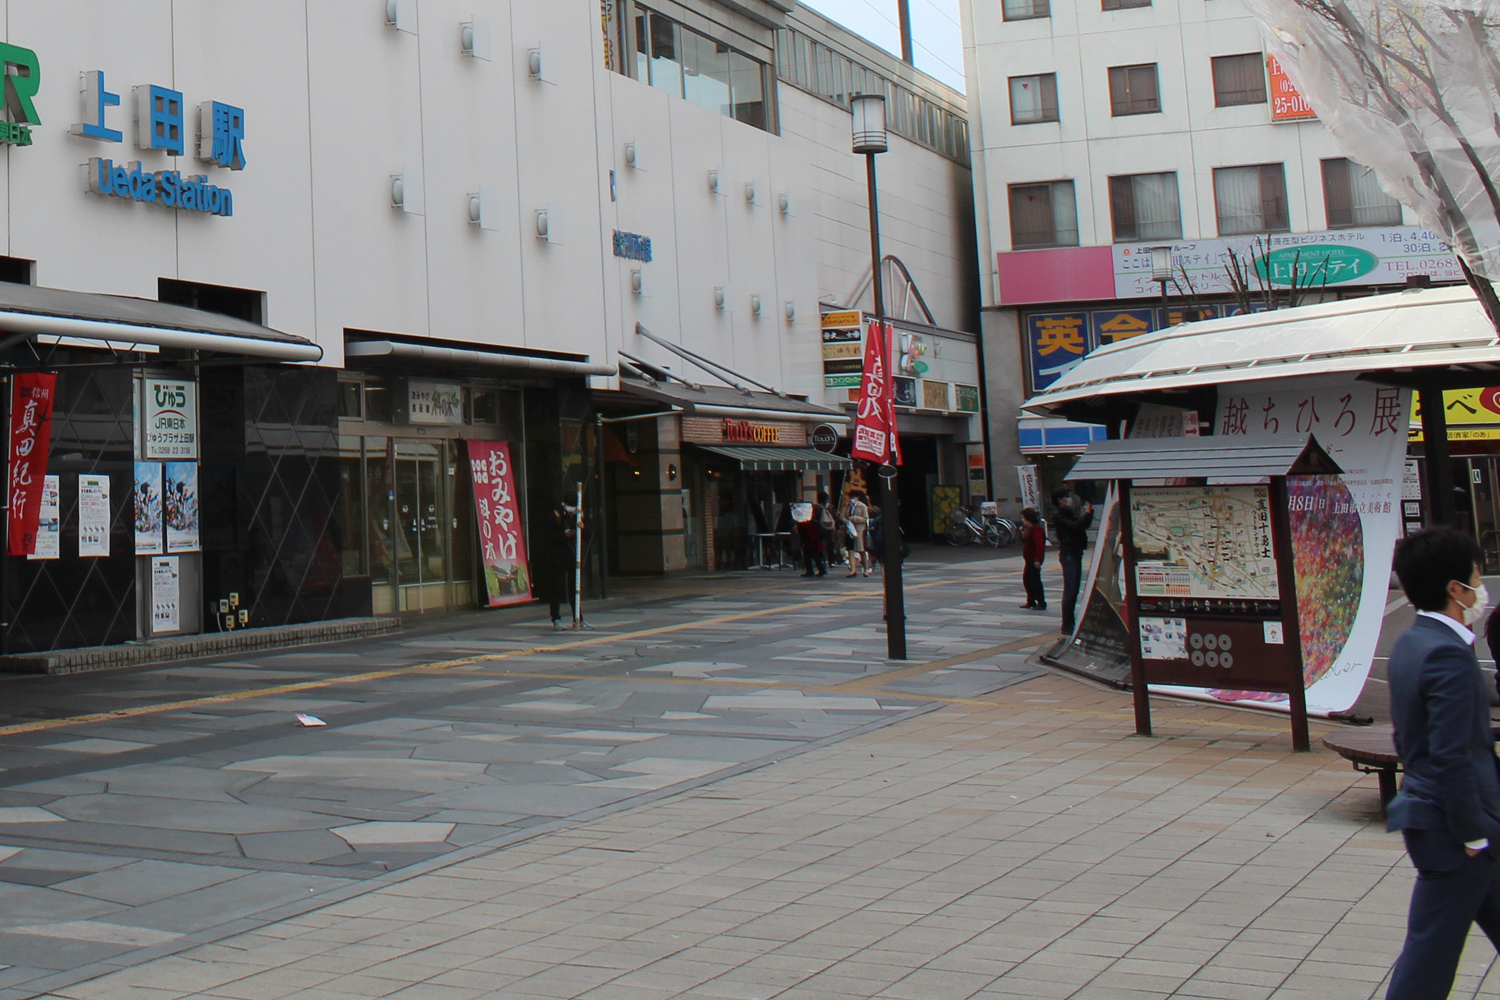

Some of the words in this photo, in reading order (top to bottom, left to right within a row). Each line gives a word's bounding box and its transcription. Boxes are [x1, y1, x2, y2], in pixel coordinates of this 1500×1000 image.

[74, 70, 247, 171] 上田駅
[93, 157, 156, 203] Ueda
[158, 170, 233, 217] Station
[154, 384, 186, 408] びゅう
[155, 417, 186, 430] JR東日本
[13, 399, 39, 521] 真田紀行
[753, 425, 780, 443] COFFEE
[488, 449, 518, 561] おみやげ
